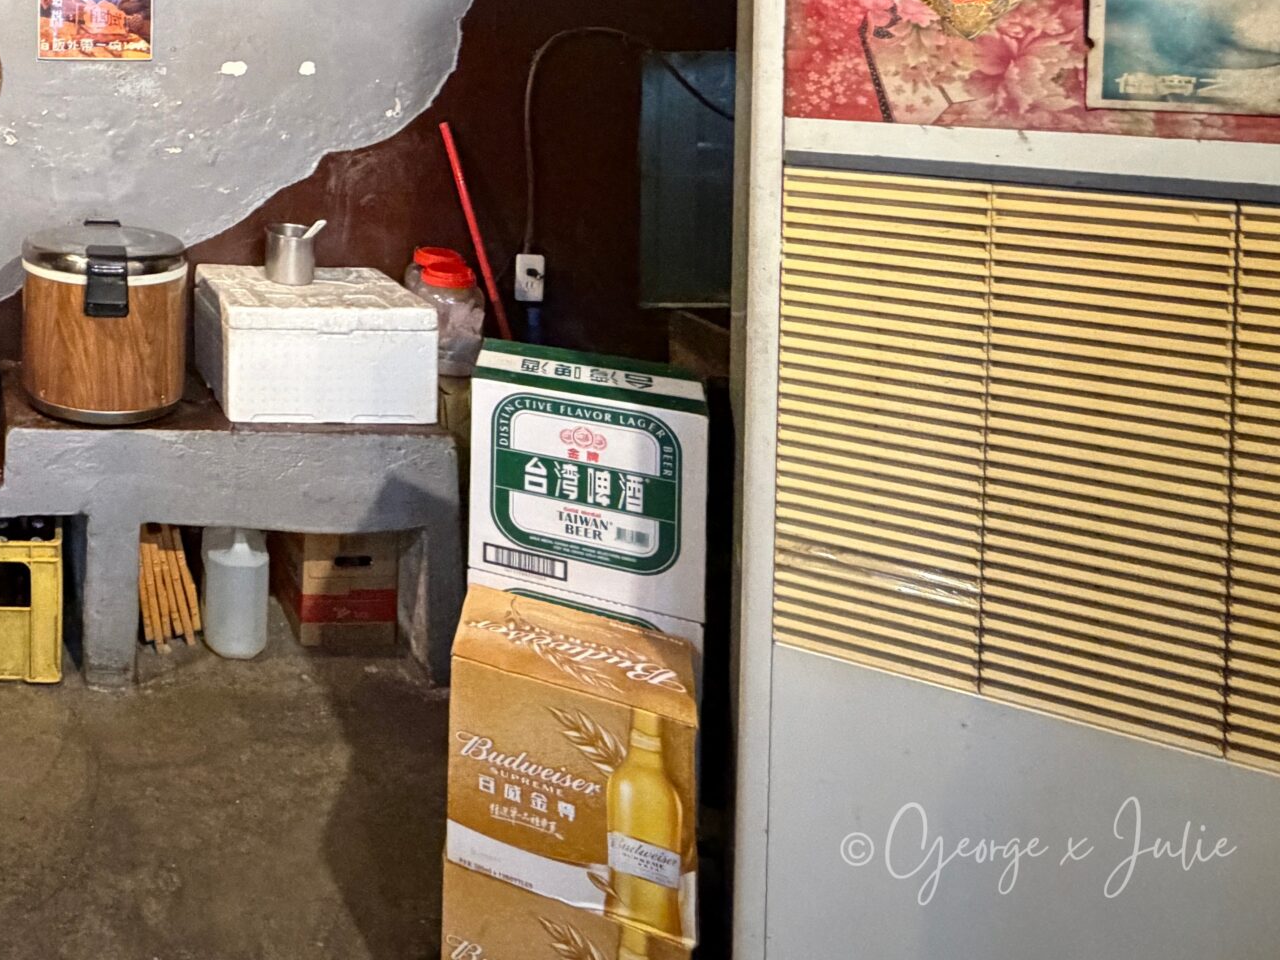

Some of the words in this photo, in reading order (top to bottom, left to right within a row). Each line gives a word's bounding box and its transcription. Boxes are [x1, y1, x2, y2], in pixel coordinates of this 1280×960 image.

[521, 358, 653, 389] 台灣啤酒
[499, 398, 553, 447] DISTINCTIVE
[559, 404, 612, 423] FLAVOR
[619, 415, 666, 439] LAGER
[662, 445, 674, 477] BEER
[567, 447, 600, 463] 金牌
[523, 456, 644, 514] 台灣啤酒
[557, 510, 609, 530] TAIWAN
[565, 523, 603, 541] BEER
[467, 619, 687, 693] Budweiser
[455, 730, 602, 796] Budweiser
[490, 766, 564, 798] SUPREME
